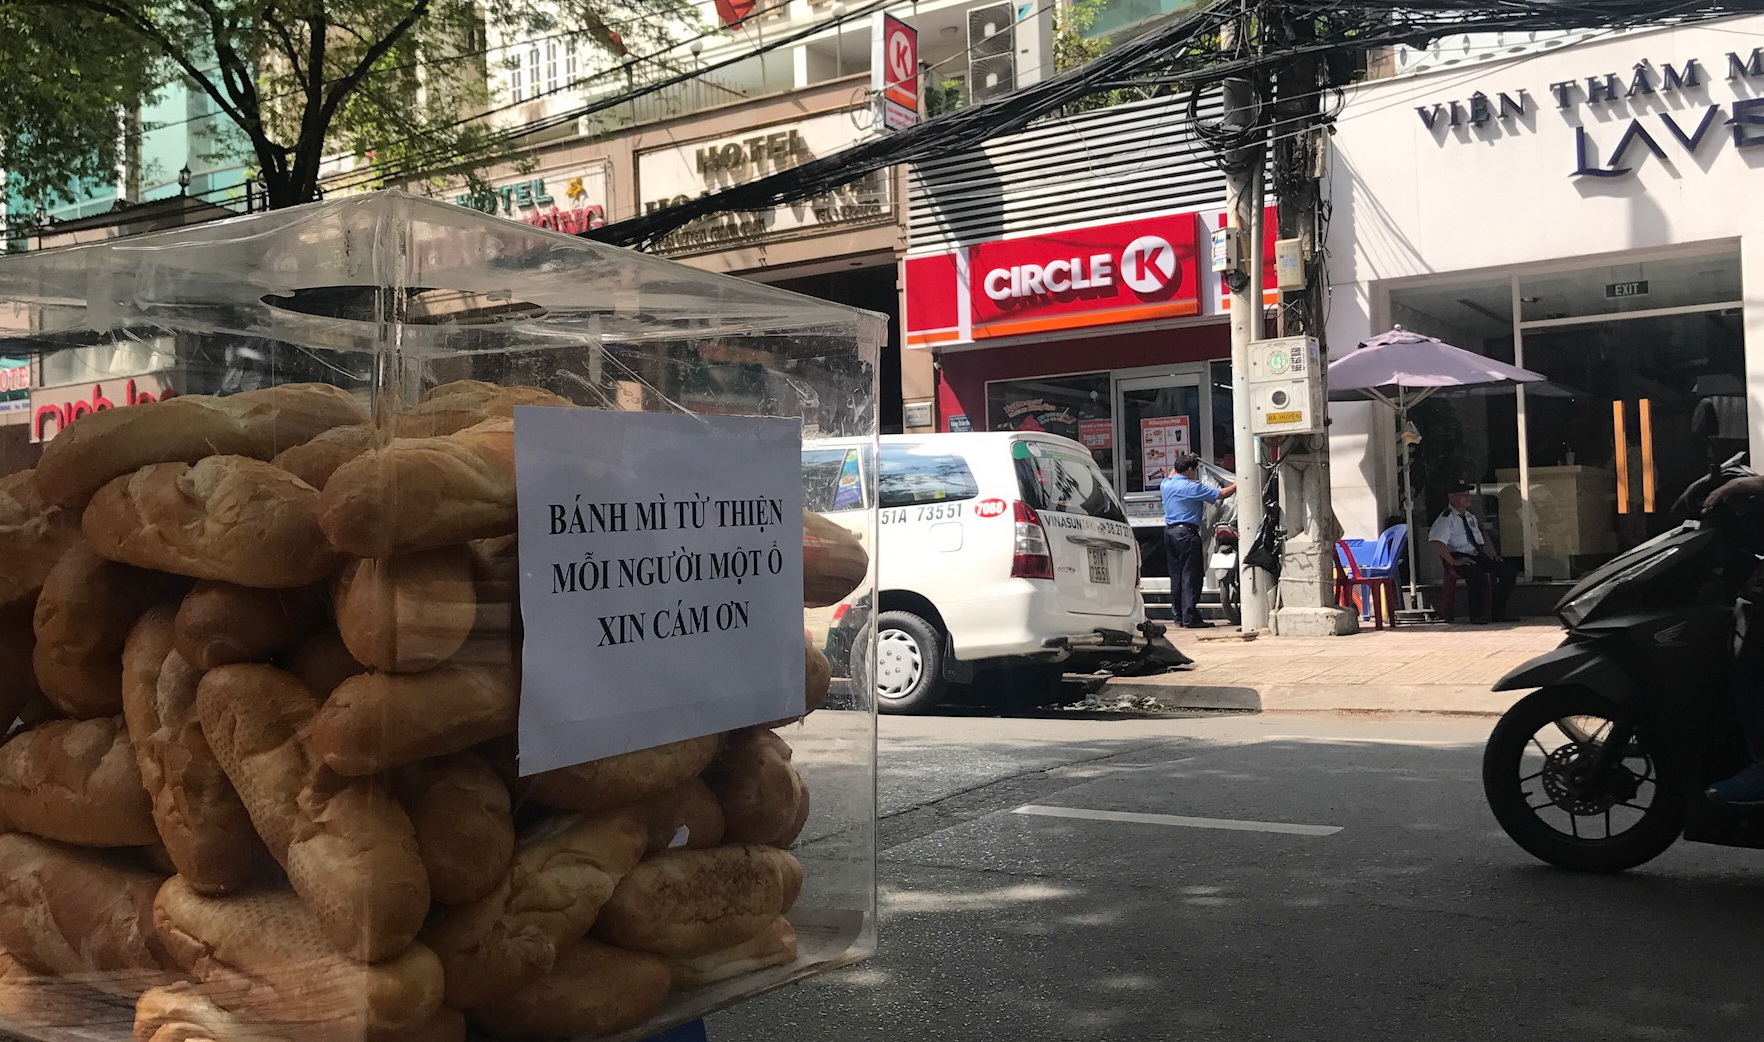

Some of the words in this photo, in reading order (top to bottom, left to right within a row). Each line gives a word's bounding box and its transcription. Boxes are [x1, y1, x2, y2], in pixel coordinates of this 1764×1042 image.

[895, 40, 909, 79] K
[1414, 89, 1526, 131] VIỆN
[1550, 58, 1700, 110] THẨM
[695, 129, 806, 175] HOTEL
[984, 253, 1112, 300] CIRCLE
[1134, 246, 1170, 289] K
[1615, 282, 1639, 296] EXIT
[549, 494, 628, 535] BÁNH
[636, 493, 668, 531] MÌ
[674, 493, 710, 529] TỪ
[715, 495, 783, 533] THIỆN
[881, 509, 907, 525] 51A
[976, 501, 1003, 516] 7068
[552, 552, 610, 594] MỖI
[618, 546, 702, 588] NGƯỜI
[709, 546, 762, 585] MỘT
[768, 541, 783, 575] Ổ
[597, 613, 646, 647] XIN
[653, 600, 710, 639] CÁM
[716, 600, 750, 631] ƠN
